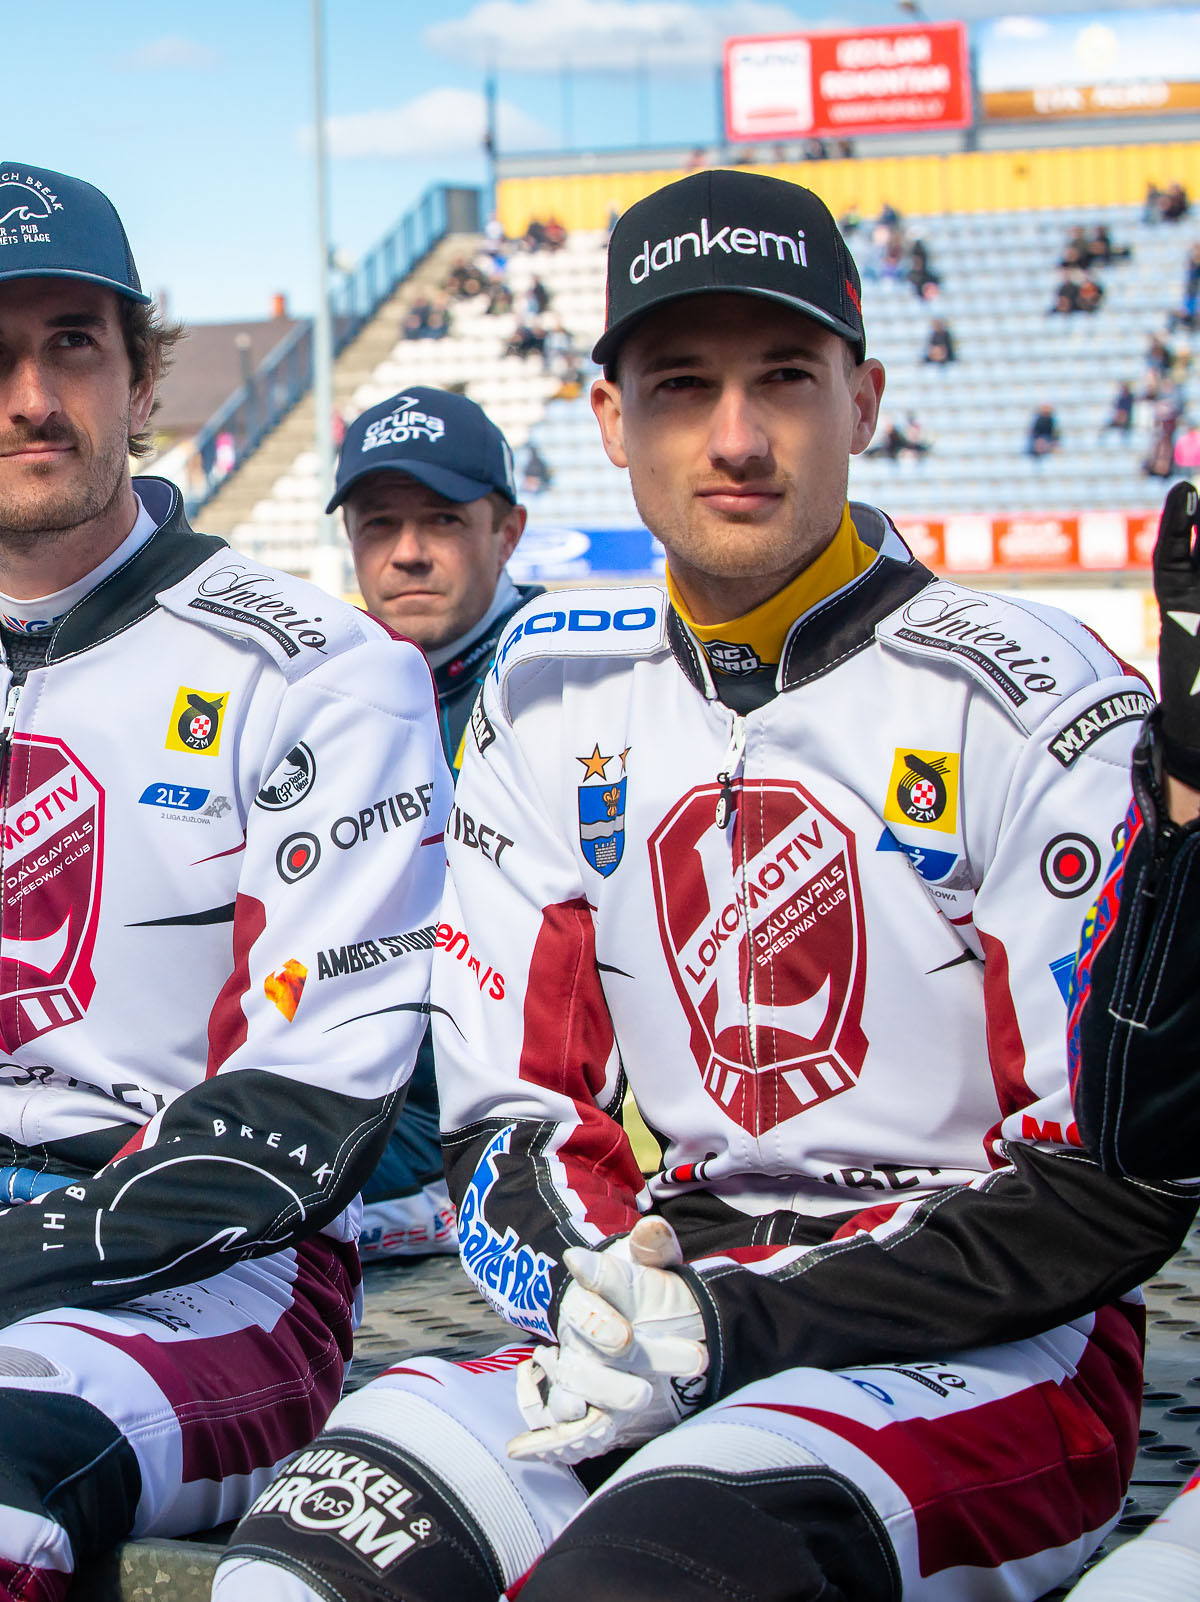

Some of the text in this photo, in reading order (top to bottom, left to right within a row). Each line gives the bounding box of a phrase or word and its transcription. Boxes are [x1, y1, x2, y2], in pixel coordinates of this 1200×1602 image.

[25, 176, 64, 211] BREAK
[20, 224, 39, 235] PUB
[23, 233, 51, 243] PLAGE
[629, 217, 808, 285] dankemi
[185, 735, 209, 749] PZM
[906, 805, 937, 822] PZM
[5, 821, 94, 890] DAUGAVPILS
[7, 843, 91, 907] SPEEDWAY CLUB
[684, 818, 824, 986] LOKOMOTIV
[754, 864, 845, 948] DAUGAVPILS
[756, 888, 847, 967] SPEEDWAY CLUB
[316, 939, 388, 981] AMBER
[212, 1118, 335, 1186] BREAK
[285, 1449, 432, 1540] NIKKEL &
